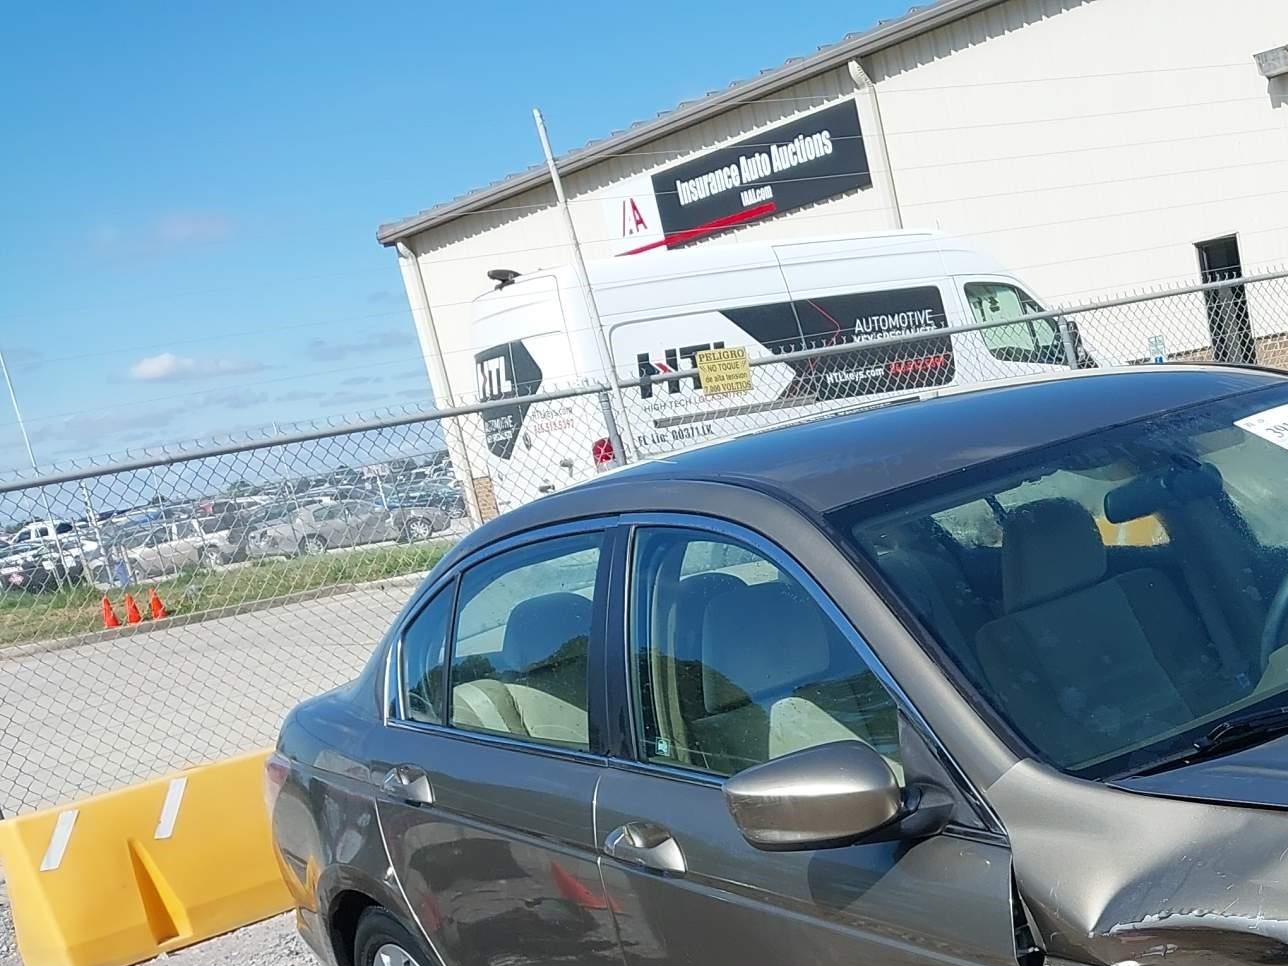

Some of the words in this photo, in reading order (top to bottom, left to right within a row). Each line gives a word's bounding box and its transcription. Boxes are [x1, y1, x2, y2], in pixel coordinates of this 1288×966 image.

[676, 163, 742, 206] Insurance
[738, 151, 771, 184] Auto
[770, 130, 833, 173] Auctions
[740, 185, 773, 207] IAAI.com
[855, 309, 933, 334] AUTOMOTIVE
[698, 349, 745, 362] PELIGRO
[707, 364, 717, 372] NO
[719, 361, 740, 371] TOQUE
[722, 380, 751, 391] VOLTIOS
[643, 400, 667, 413] HIGH
[669, 397, 692, 409] TECH
